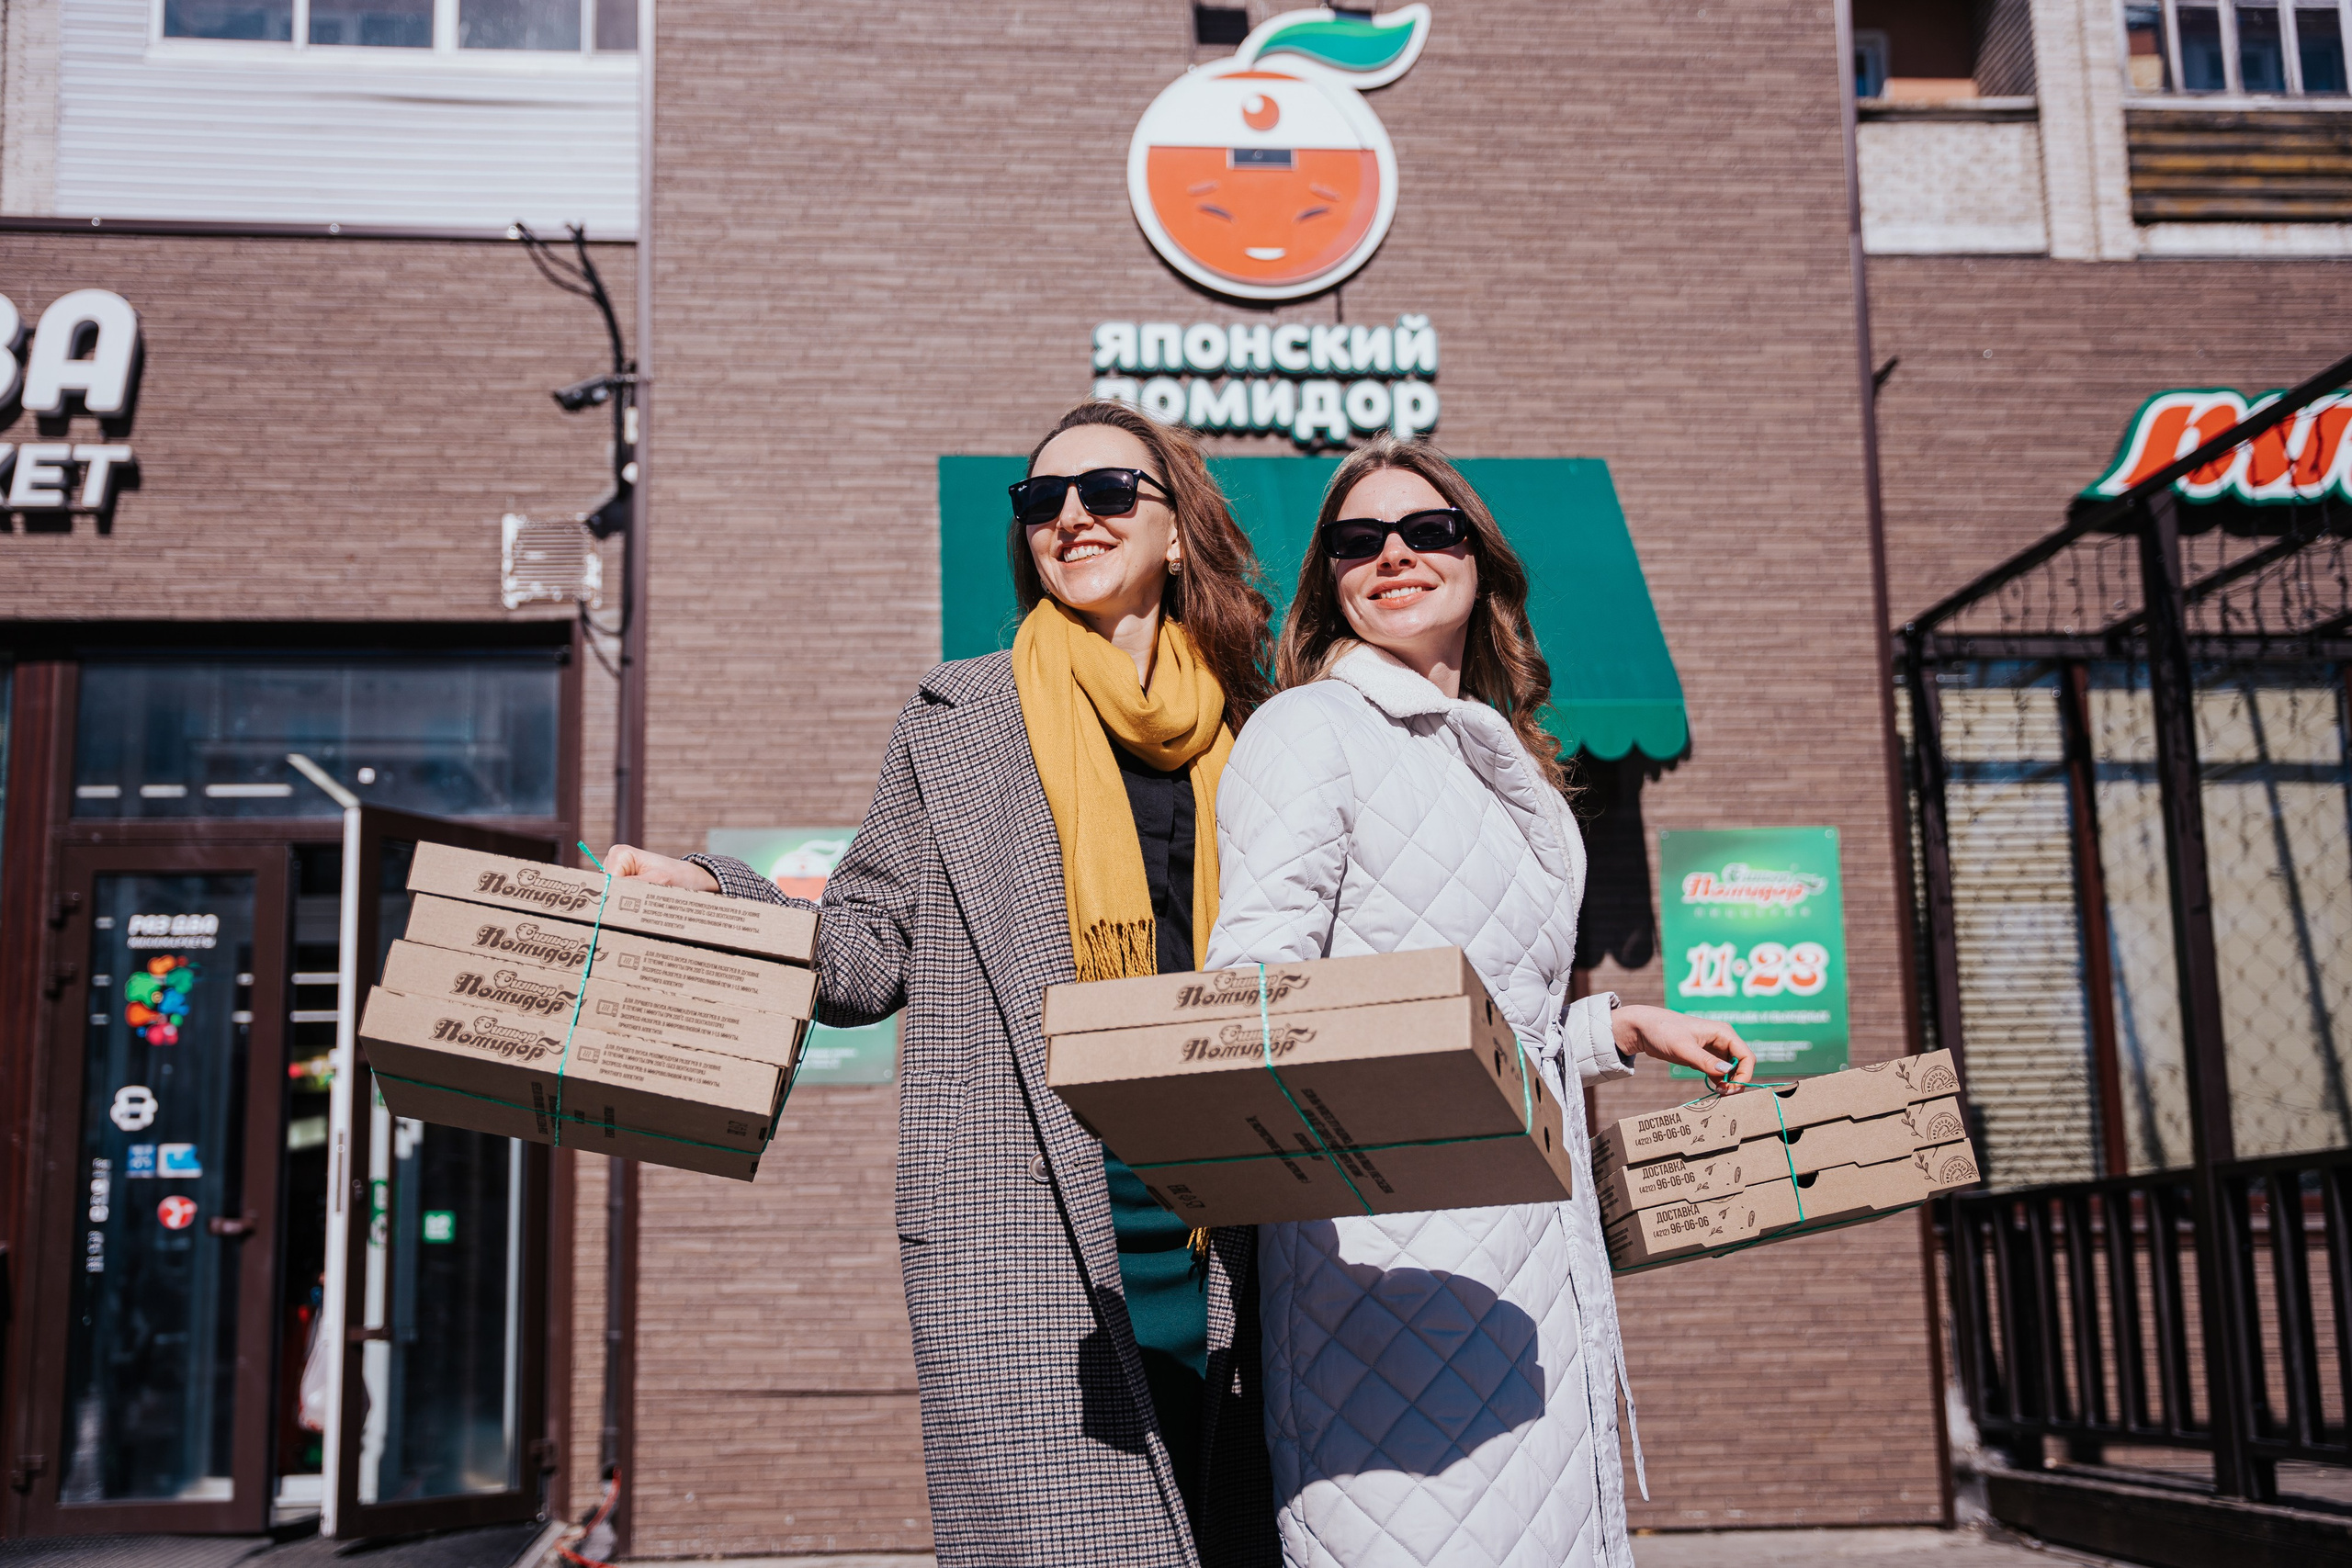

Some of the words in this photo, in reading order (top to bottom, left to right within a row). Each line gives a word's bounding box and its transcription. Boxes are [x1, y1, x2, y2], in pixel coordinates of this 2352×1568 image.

[0, 288, 138, 412] А
[474, 871, 589, 913] Помидор
[655, 895, 674, 903] ЛУЧШЕГО
[688, 900, 718, 910] РЕКОМЕНДУЕМ
[640, 917, 663, 926] ПРИЯТНОГО
[687, 916, 721, 927] МИКРОВОЛНОВОЙ
[472, 925, 587, 969] Помидор
[654, 952, 673, 961] ЛУЧШЕГО
[687, 958, 718, 969] РЕКОМЕНДУЕМ
[718, 964, 737, 973] РАЗОГРЕВ
[741, 969, 759, 977] ДУХОВКЕ
[666, 962, 684, 970] МИНУТЫ
[639, 975, 662, 984] ПРИЯТНОГО
[686, 975, 720, 986] МИКРОВОЛНОВОЙ
[1214, 972, 1278, 992] Синьр
[449, 972, 566, 1016] Помидор
[626, 1004, 642, 1012] ТЕЧЕНИЕ
[645, 1009, 663, 1017] МИНУТЫ
[633, 998, 652, 1008] ЛУЧШЕГО
[652, 1002, 666, 1010] ВКУСА
[666, 1005, 696, 1016] РЕКОМЕНДУЕМ
[696, 1011, 717, 1020] РАЗОГРЕВ
[720, 1016, 740, 1024] ДУХОВКЕ
[617, 1021, 640, 1031] ПРИЯТНОГО
[665, 1021, 700, 1033] МИКРОВОЛНОВОЙ
[1220, 1024, 1284, 1044] Синьр
[429, 1018, 547, 1063] Помидор
[606, 1051, 624, 1059] ТЕЧЕНИЕ
[615, 1045, 634, 1054] ЛУЧШЕГО
[648, 1052, 678, 1063] РЕКОМЕНДУЕМ
[678, 1057, 698, 1066] РАЗОГРЕВ
[702, 1062, 720, 1071] ДУХОВКЕ
[599, 1068, 622, 1077] ПРИЯТНОГО
[647, 1068, 682, 1079] МИКРОВОЛНОВОЙ
[1638, 1112, 1682, 1133] ДОСТАВКА
[1635, 1136, 1652, 1146] (4212)
[1653, 1124, 1691, 1142] 96-06-06
[1642, 1160, 1686, 1179] ДОСТАВКА
[1639, 1184, 1657, 1193] (4212)
[1657, 1172, 1696, 1190] 96-06-06
[1656, 1204, 1700, 1224] ДОСТАВКА
[1653, 1228, 1670, 1238] (4212)
[1670, 1216, 1710, 1234] 96-06-06
